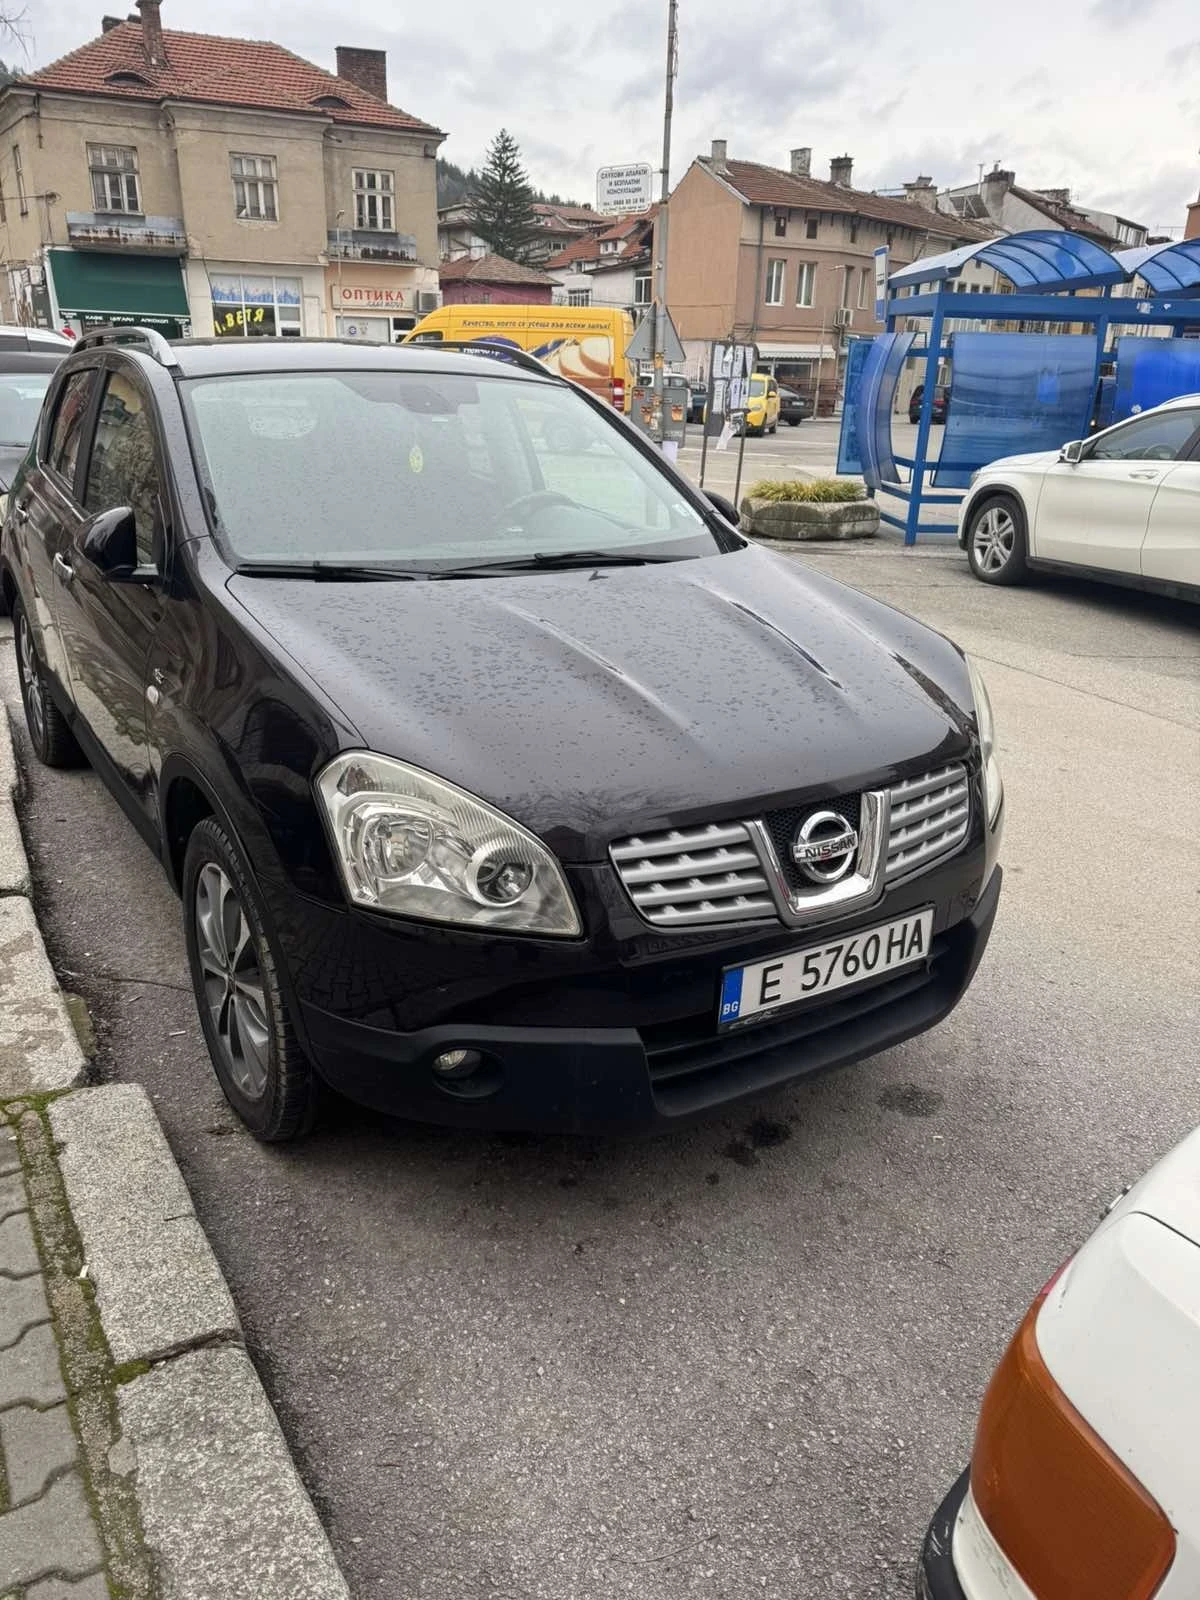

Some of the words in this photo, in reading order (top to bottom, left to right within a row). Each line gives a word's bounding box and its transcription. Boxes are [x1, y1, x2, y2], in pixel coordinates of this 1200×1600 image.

[342, 288, 404, 301] ОПТИКА
[804, 835, 856, 858] NISSAN
[759, 962, 784, 1006] E
[801, 933, 881, 992] 5760
[886, 918, 923, 965] HA
[722, 1000, 739, 1016] BG
